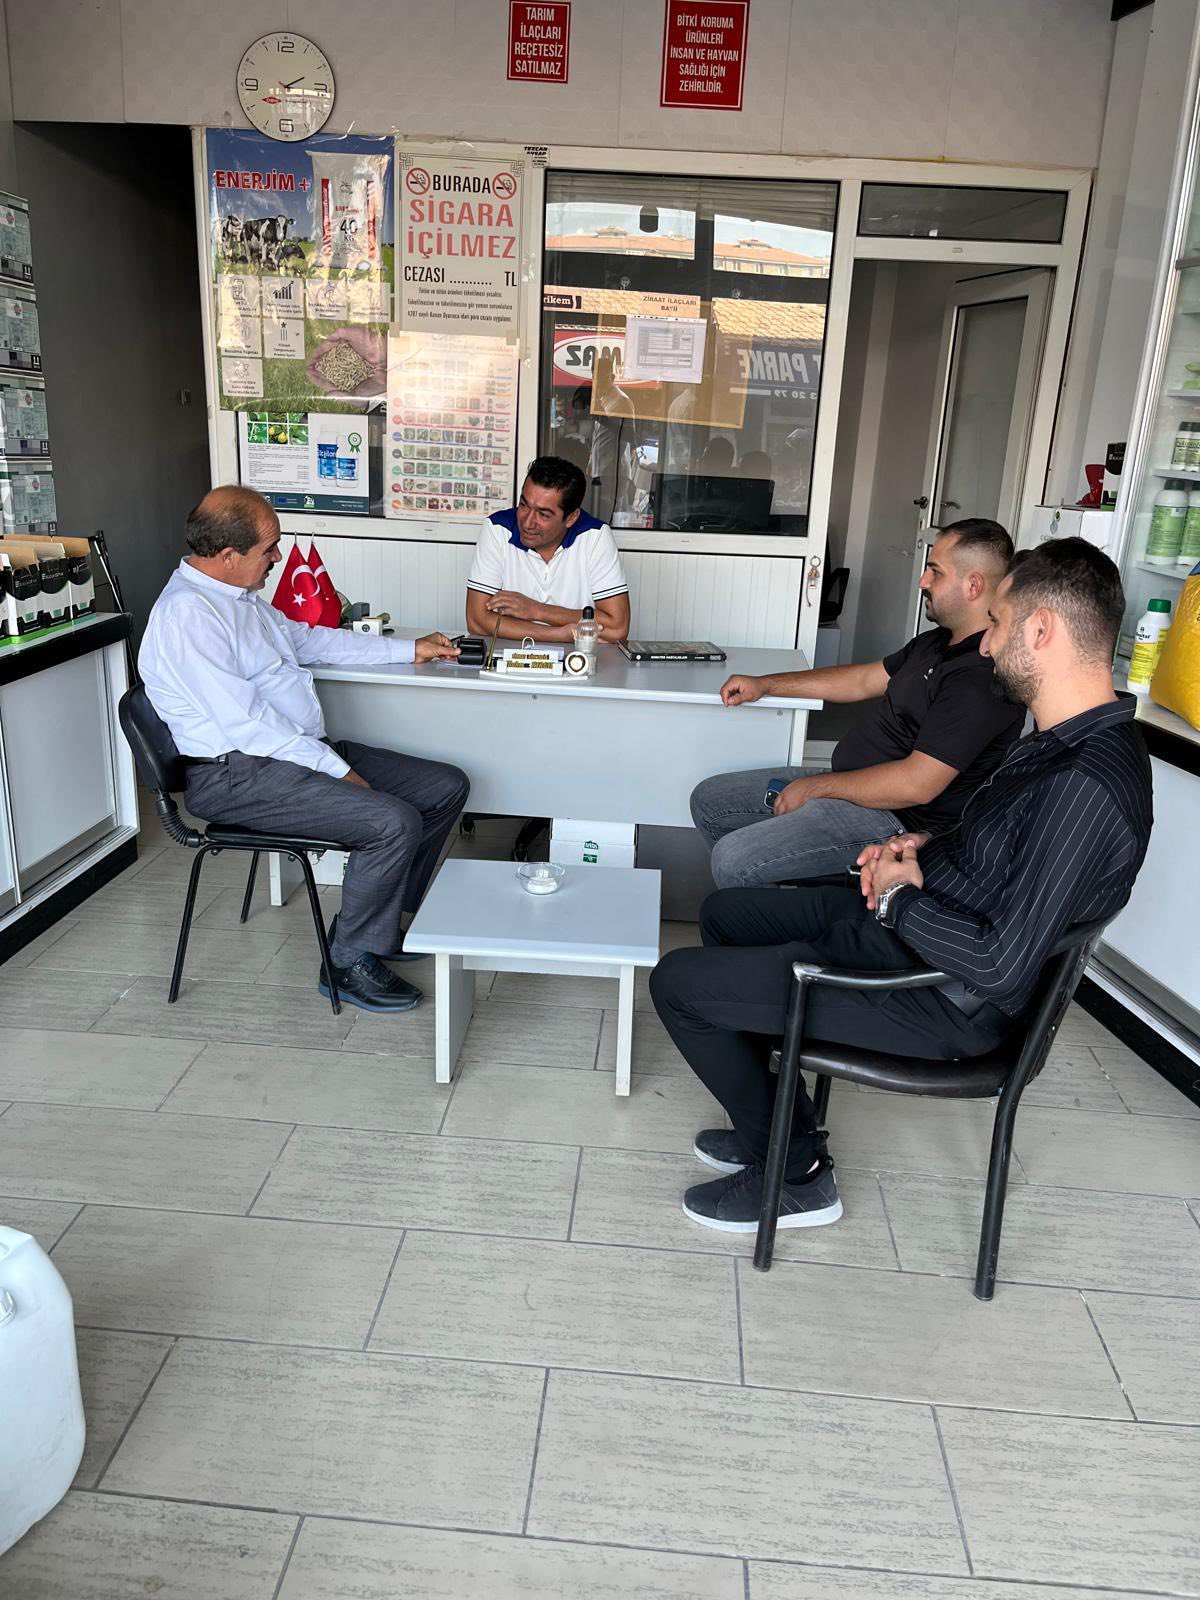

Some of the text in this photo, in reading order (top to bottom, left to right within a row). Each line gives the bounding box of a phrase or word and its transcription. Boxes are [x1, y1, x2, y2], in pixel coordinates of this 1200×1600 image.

[526, 7, 555, 21] TARIM
[677, 13, 734, 29] BİTKİ KORUMA
[520, 22, 561, 40] İLAÇLARI
[685, 30, 724, 45] ÜRÜNLERİ
[277, 41, 295, 53] 12
[514, 42, 564, 58] REÇETESİZ
[670, 44, 739, 62] İNSAN VE HAYVAN
[515, 59, 561, 75] SATILMAZ
[679, 62, 726, 78] SAĞLIĞI İÇİN
[244, 78, 258, 91] 9
[678, 79, 724, 93] ZEHİRLİDİR.
[279, 119, 294, 132] 6
[214, 169, 295, 192] ENERJİM
[432, 174, 491, 194] BURADA
[409, 195, 514, 227] SİGARA
[407, 226, 516, 259] İÇİLMEZ
[404, 265, 445, 283] CEZASI
[504, 271, 518, 287] TL
[643, 295, 697, 306] ZİRAAT İLAÇLARI
